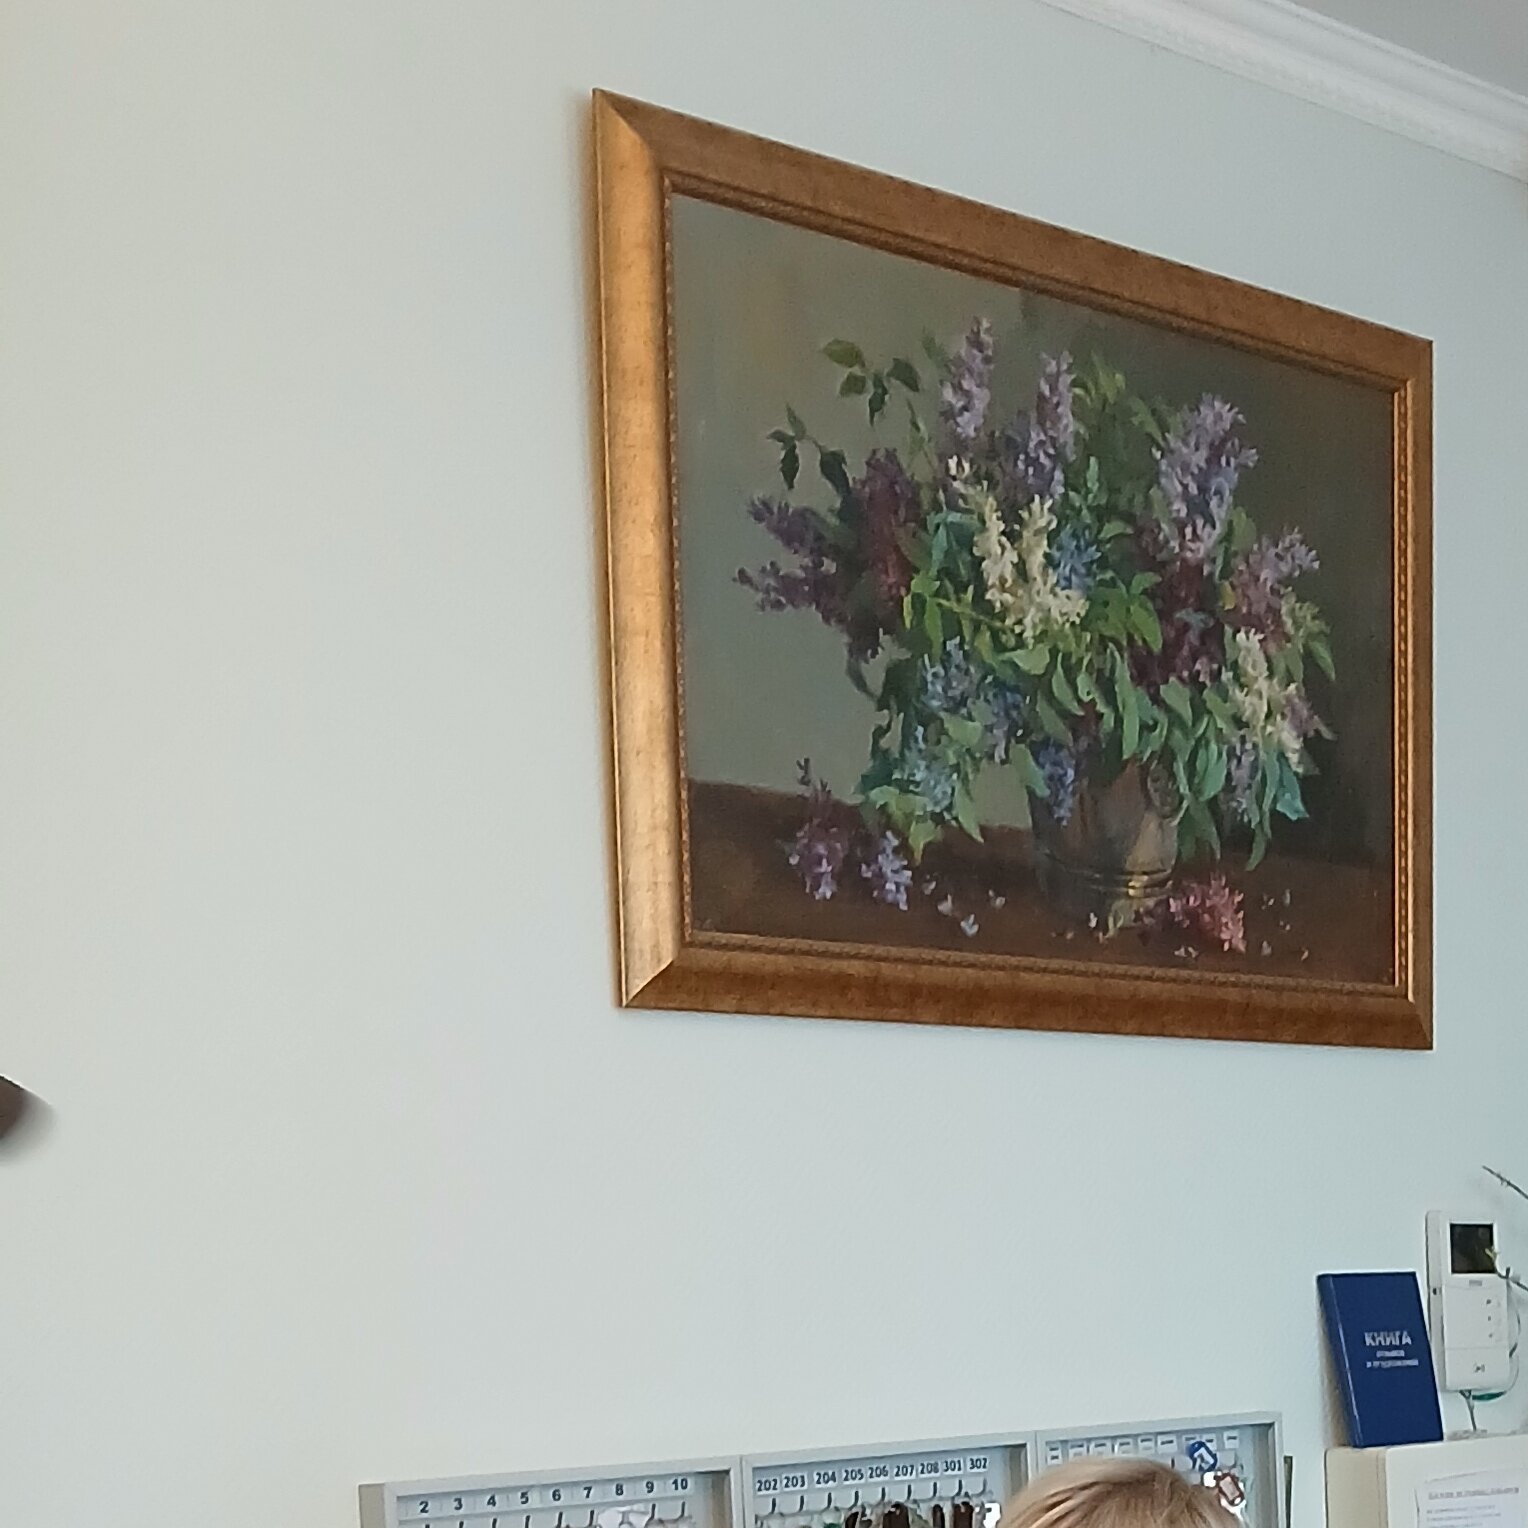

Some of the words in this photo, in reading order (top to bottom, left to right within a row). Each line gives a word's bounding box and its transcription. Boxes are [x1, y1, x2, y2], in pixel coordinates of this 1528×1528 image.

[1364, 1330, 1412, 1346] КНИГА
[757, 1479, 778, 1492] 202
[784, 1476, 805, 1488] 203
[816, 1472, 836, 1484] 204
[843, 1469, 864, 1482] 205
[868, 1467, 889, 1479] 206
[895, 1465, 914, 1477] 207
[919, 1462, 939, 1475] 208
[944, 1459, 962, 1473] 301
[969, 1458, 988, 1470] 302
[420, 1501, 429, 1513] 2
[454, 1498, 463, 1510] 3
[487, 1495, 496, 1507] 4
[520, 1493, 529, 1504] 5
[552, 1489, 561, 1501] 6
[584, 1486, 593, 1498] 7
[615, 1484, 624, 1496] 8
[646, 1481, 654, 1493] 9
[672, 1478, 688, 1491] 10
